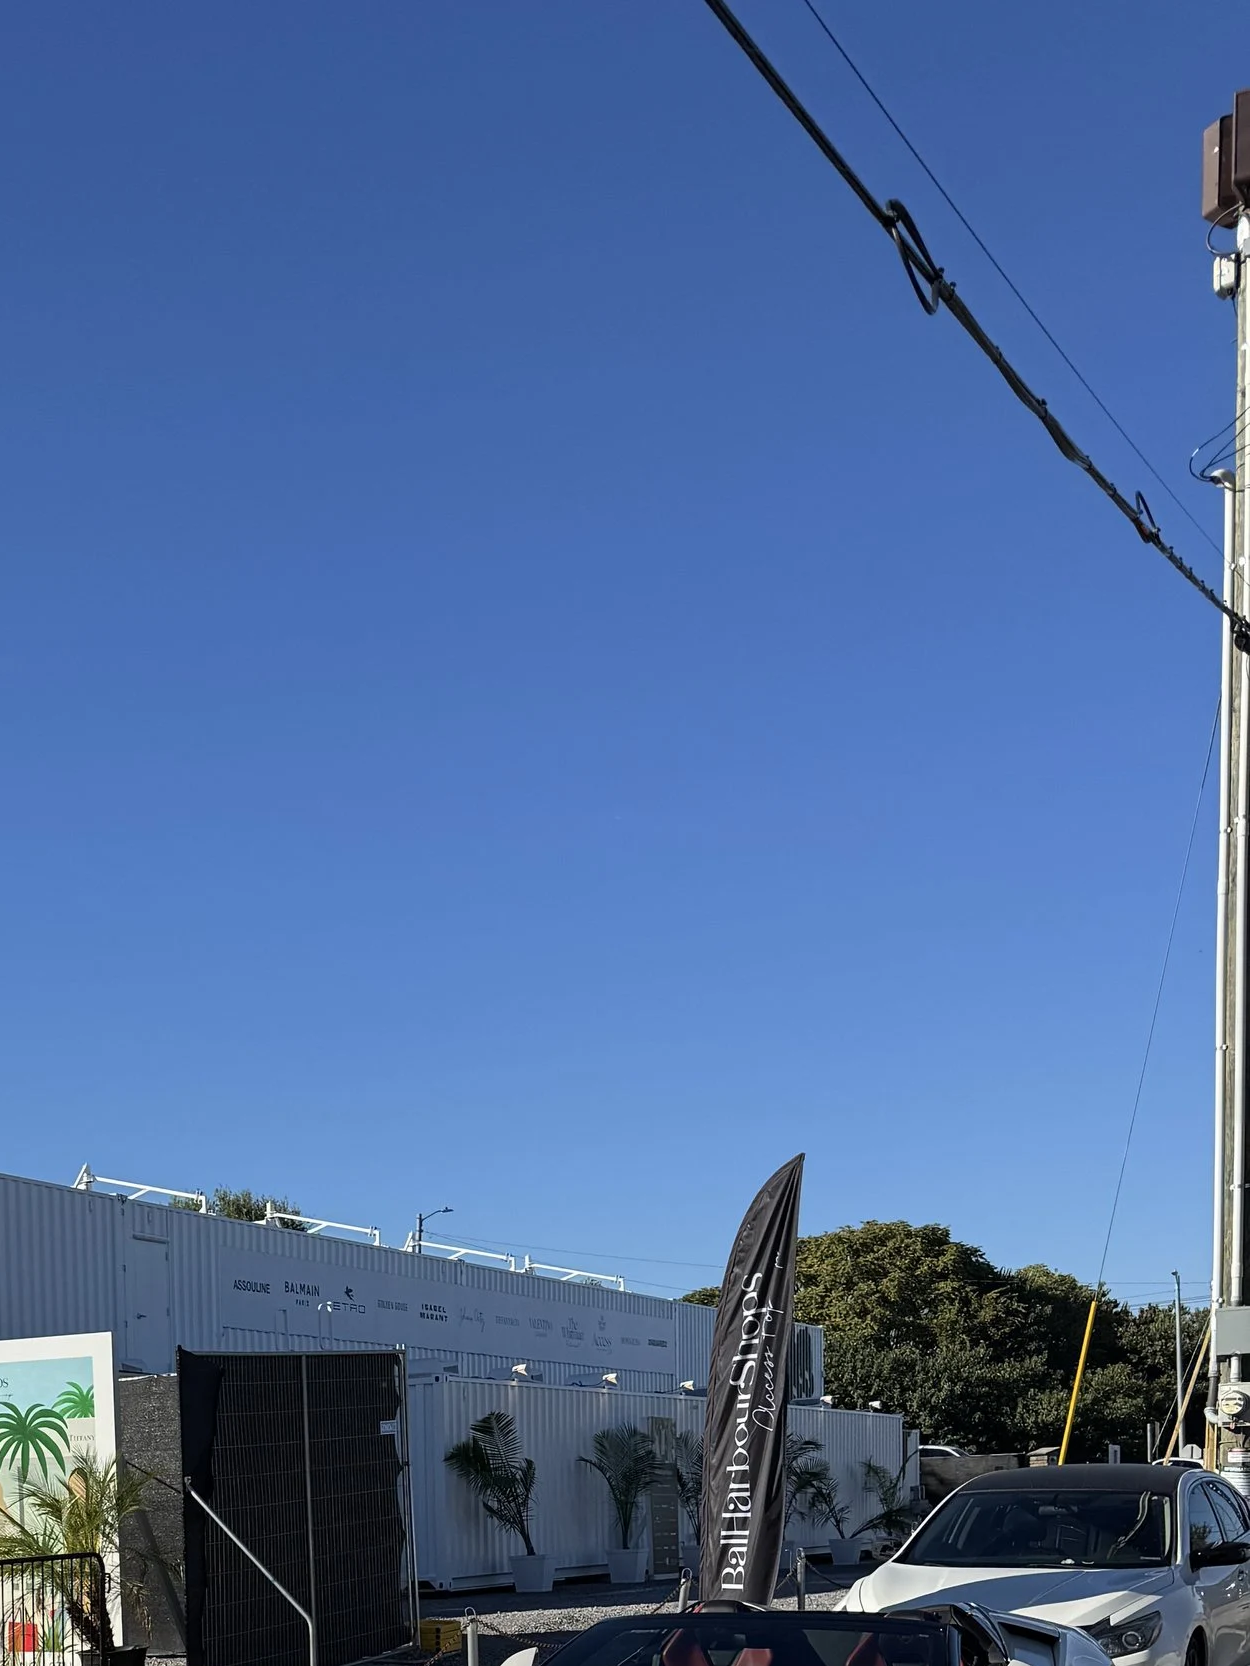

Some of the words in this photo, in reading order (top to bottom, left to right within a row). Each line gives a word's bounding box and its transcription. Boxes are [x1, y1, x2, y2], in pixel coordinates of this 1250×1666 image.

[233, 1279, 271, 1295] ASSOULINE
[284, 1281, 320, 1297] BALMAIN
[333, 1301, 366, 1314] ETRO
[419, 1311, 448, 1323] MARANT
